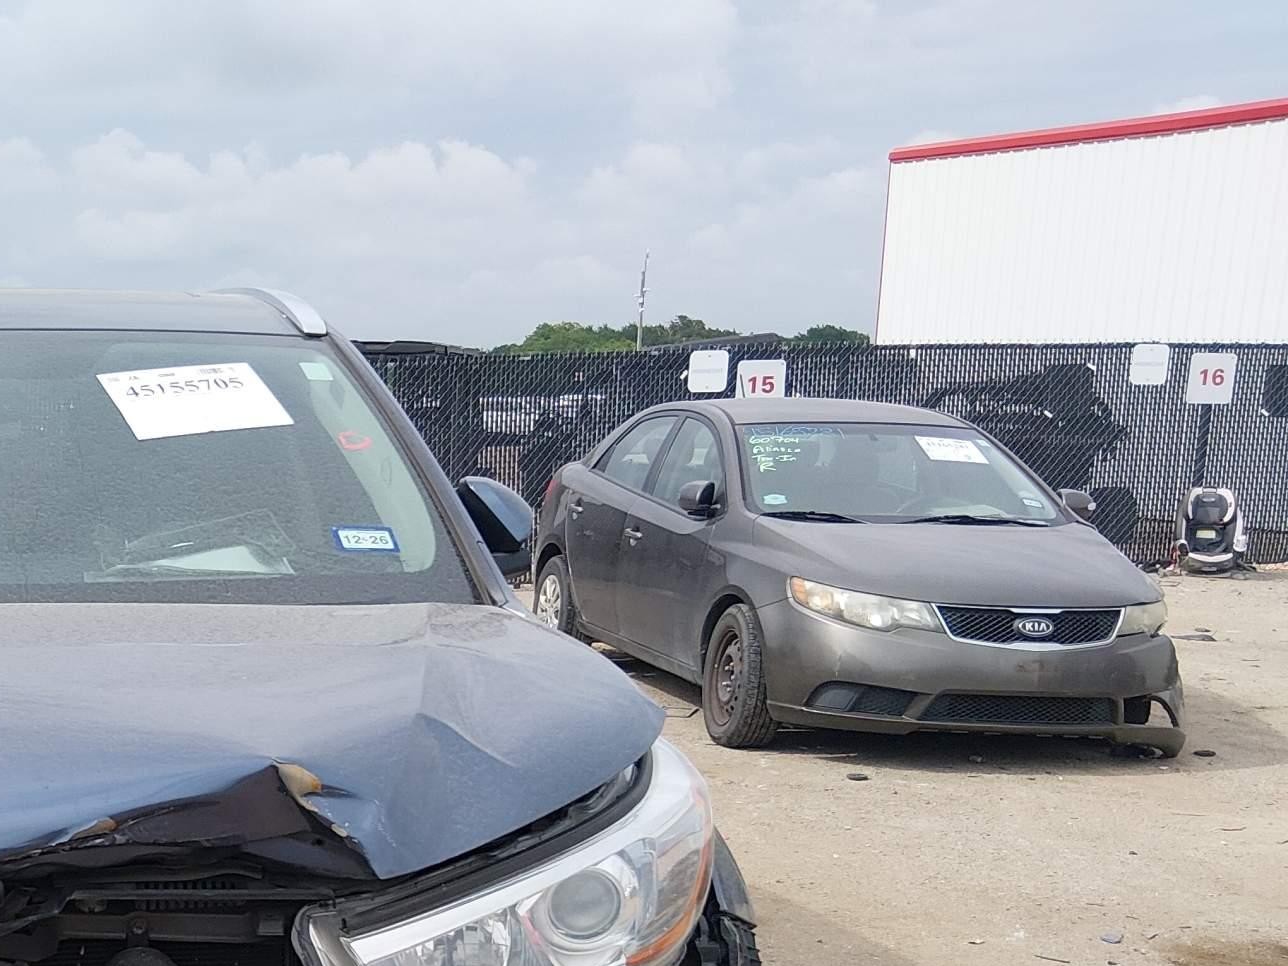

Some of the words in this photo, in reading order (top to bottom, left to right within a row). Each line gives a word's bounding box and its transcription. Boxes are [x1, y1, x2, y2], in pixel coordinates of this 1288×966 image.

[748, 375, 775, 394] 15
[1199, 368, 1225, 386] 16
[125, 376, 245, 398] 45155705
[343, 534, 390, 546] 12-26
[1025, 621, 1048, 632] KIA
